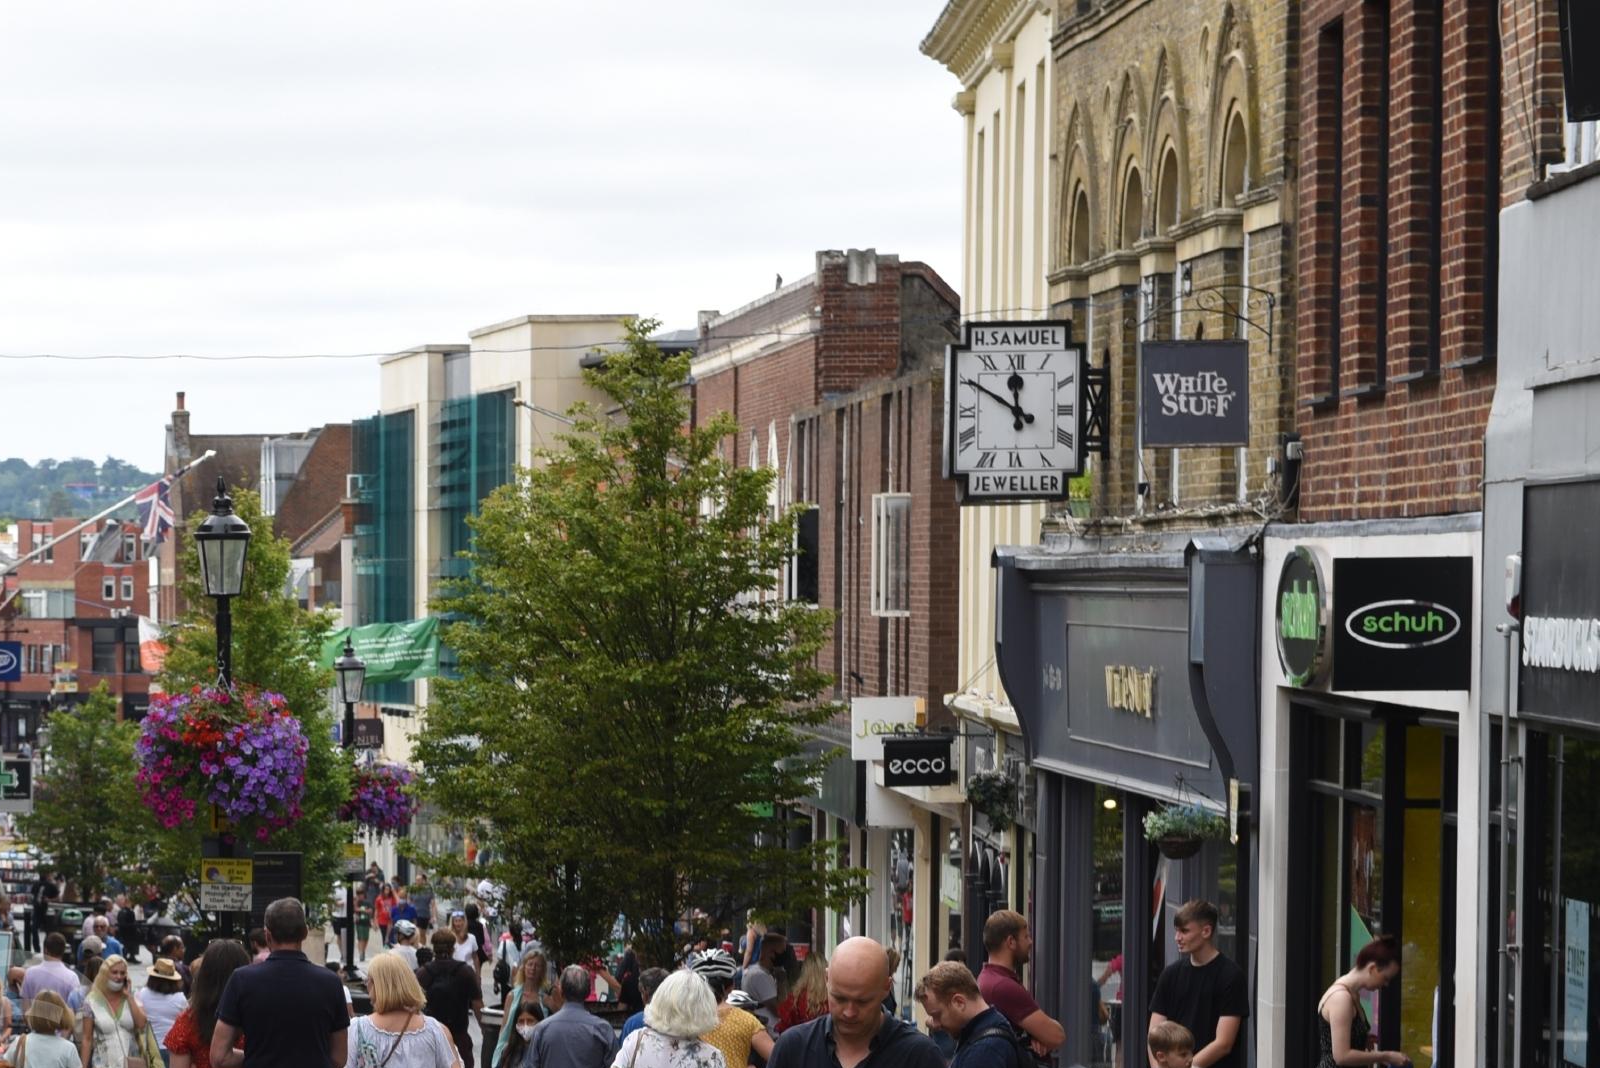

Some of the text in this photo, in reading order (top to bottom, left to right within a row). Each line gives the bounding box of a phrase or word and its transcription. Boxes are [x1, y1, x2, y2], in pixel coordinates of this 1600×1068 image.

[974, 329, 1060, 346] H.SAMUEL
[973, 475, 1060, 492] JEWELLER
[1281, 579, 1317, 640] schuh
[1362, 611, 1444, 633] schuh
[889, 758, 945, 775] ecco
